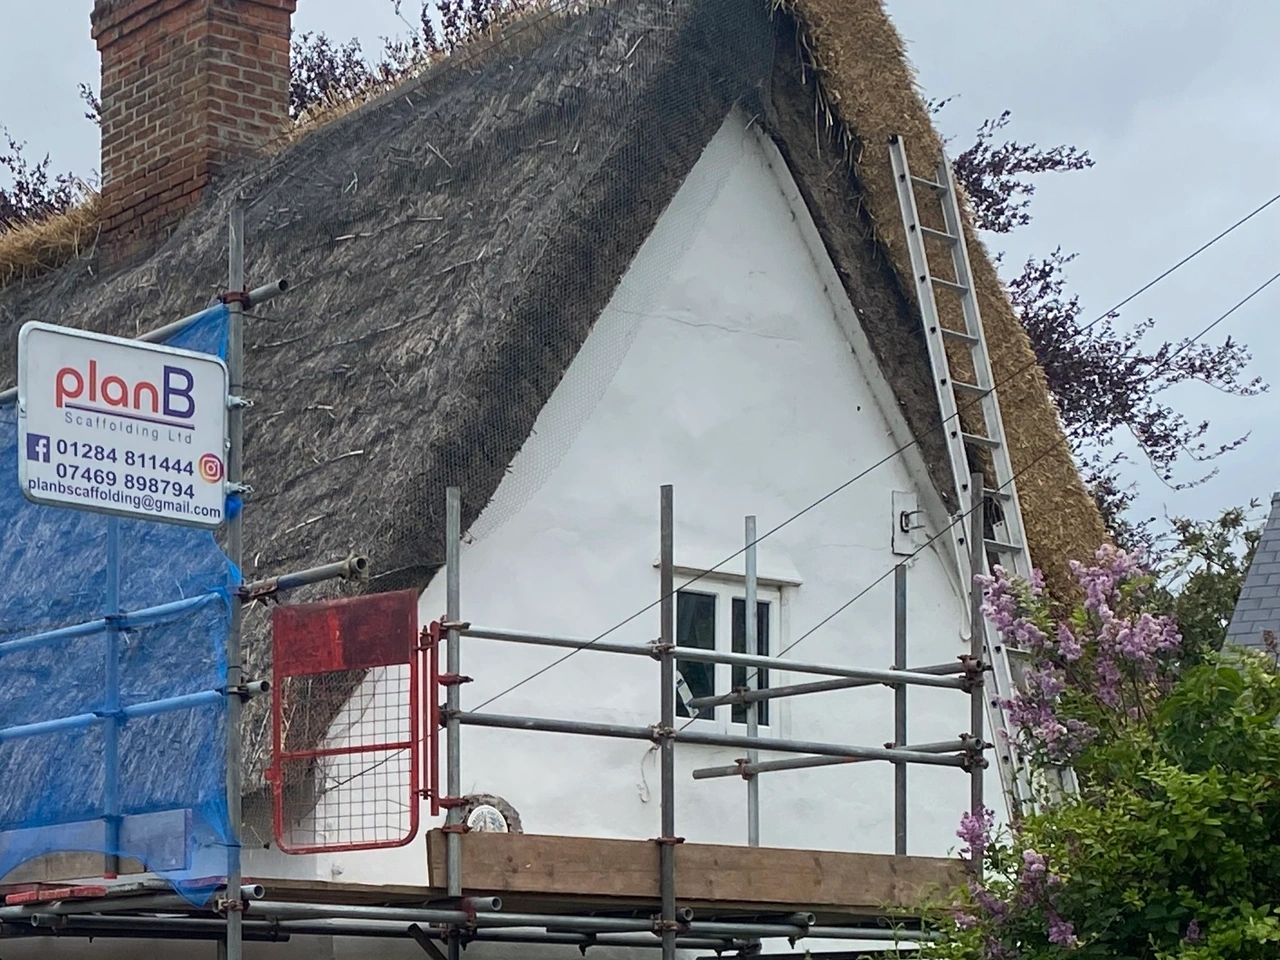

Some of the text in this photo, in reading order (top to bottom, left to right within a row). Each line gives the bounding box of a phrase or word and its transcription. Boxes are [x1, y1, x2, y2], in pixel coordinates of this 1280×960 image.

[55, 360, 196, 419] planB
[64, 412, 192, 444] Scaffolding Ltd
[56, 439, 195, 476] 01284 811444
[28, 478, 221, 518] planbscaffolding@gmail.com
[56, 463, 195, 499] 07469 898794
